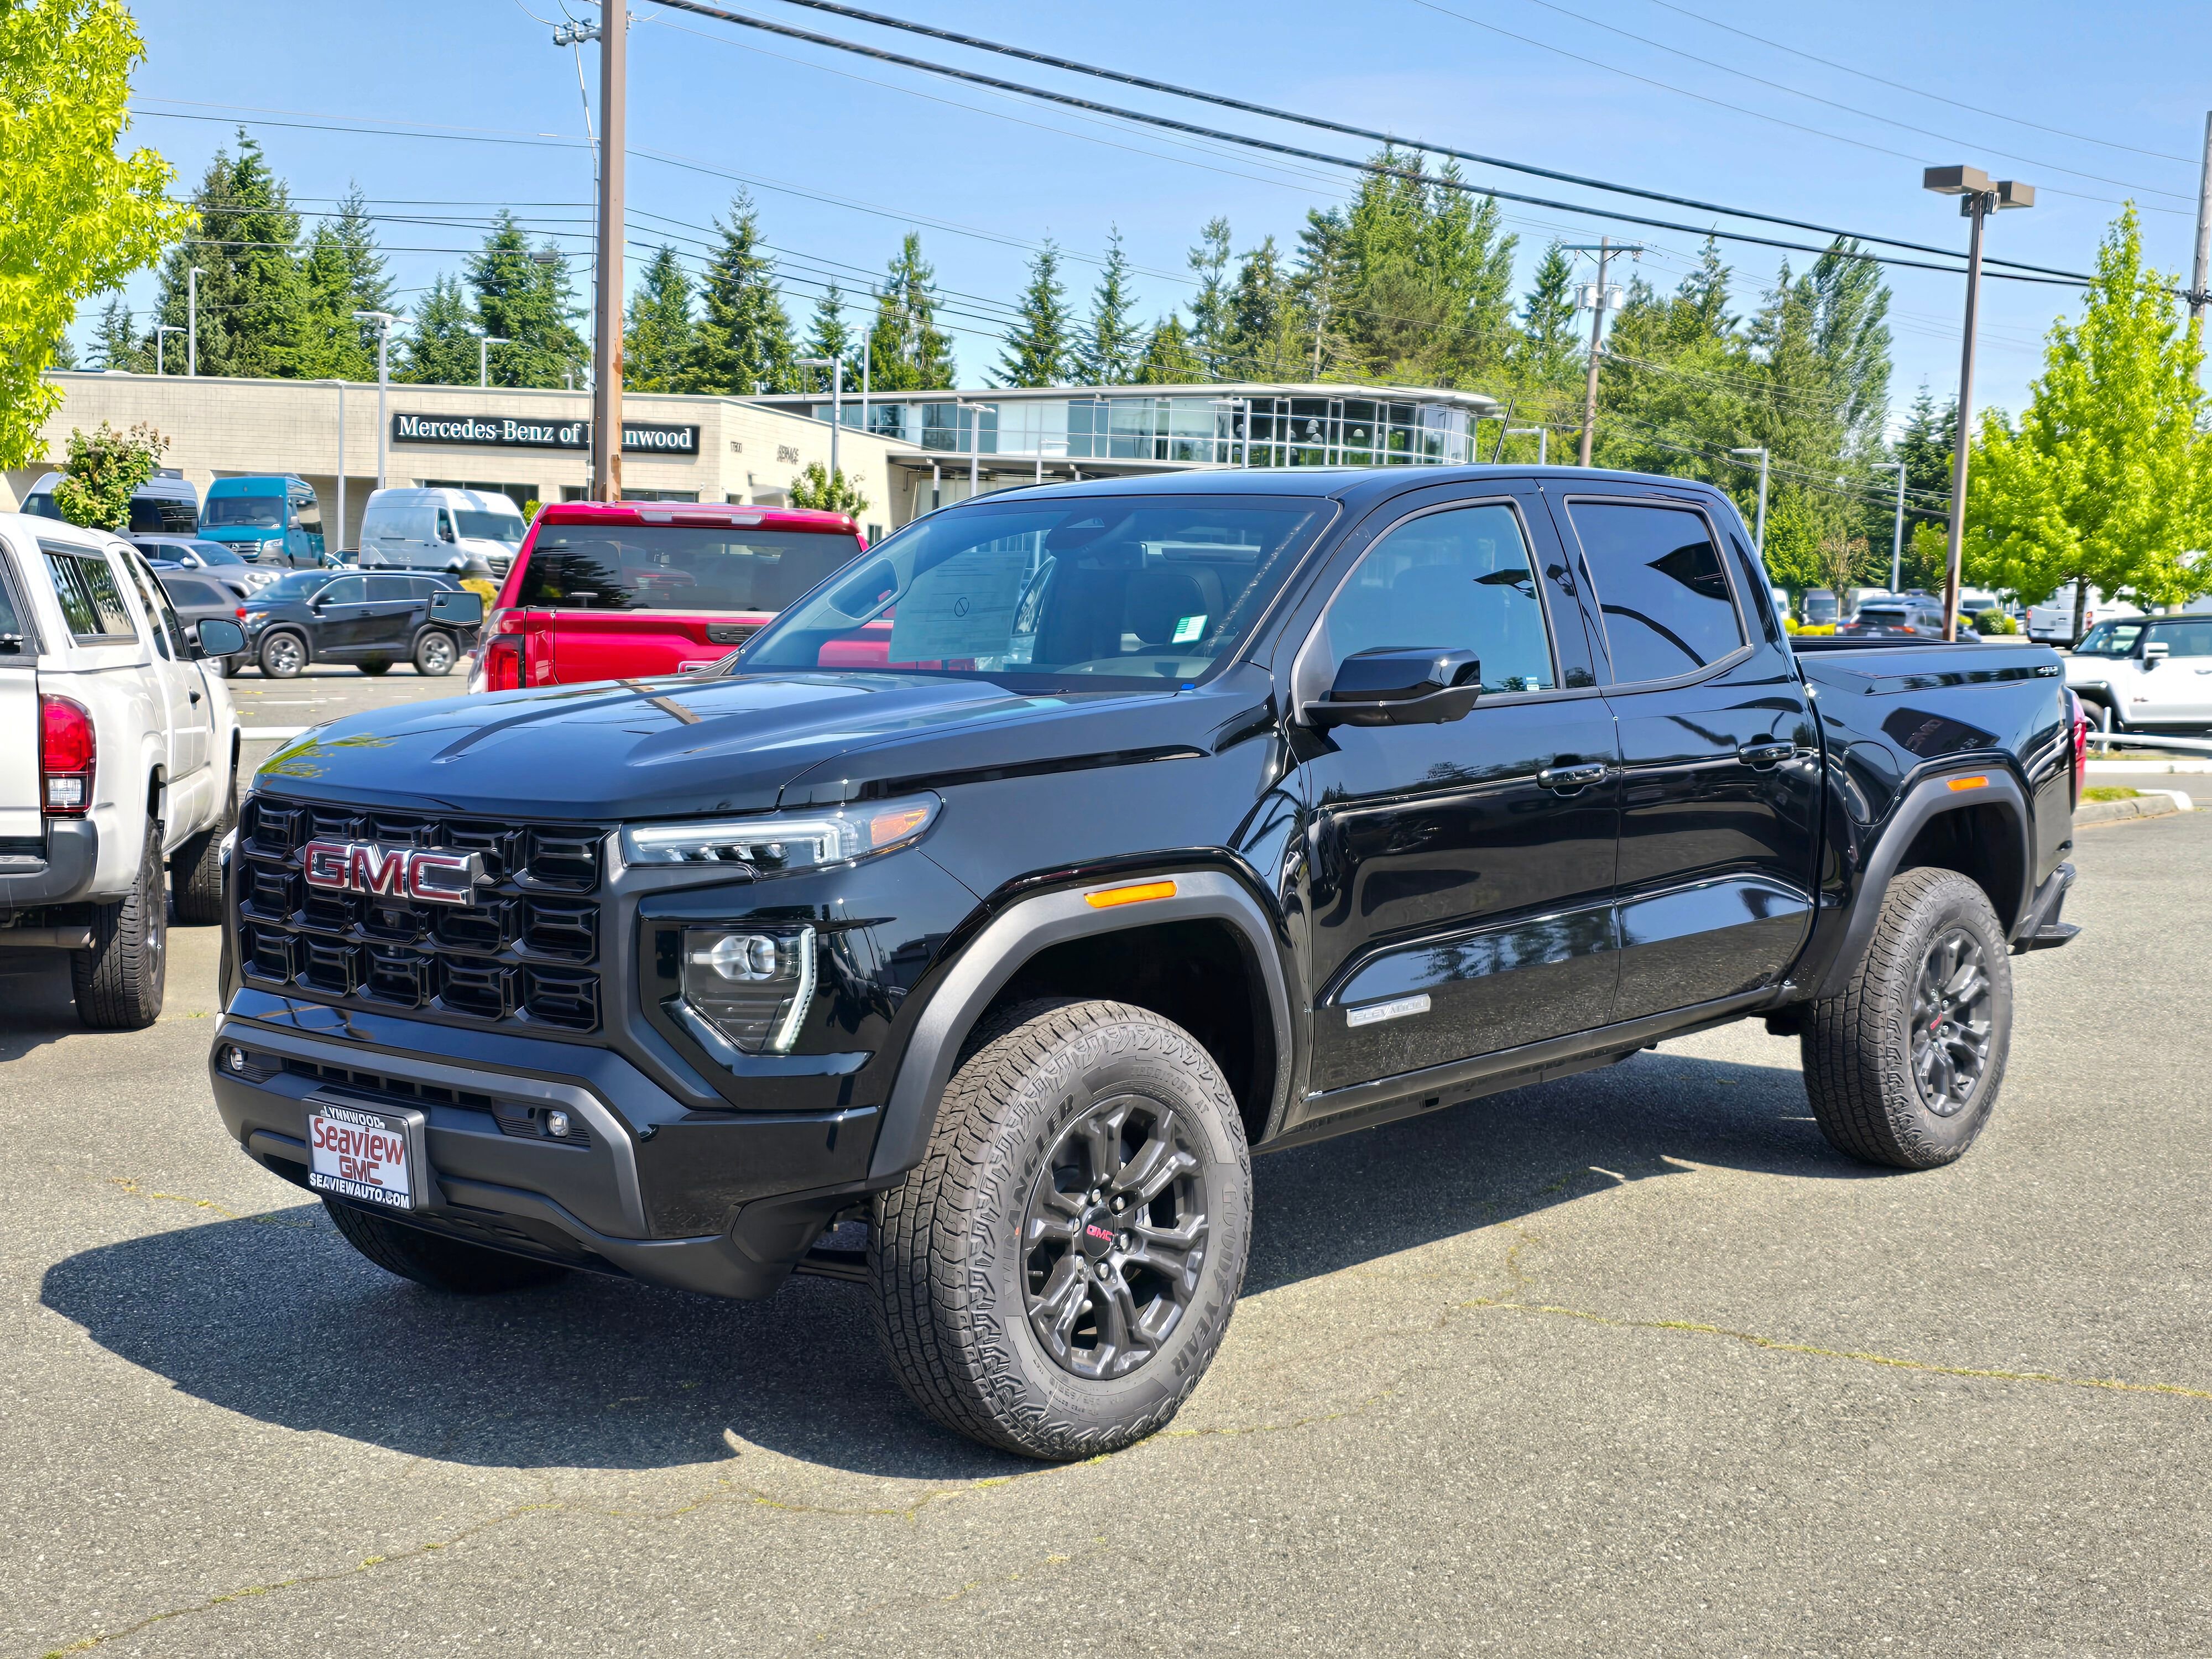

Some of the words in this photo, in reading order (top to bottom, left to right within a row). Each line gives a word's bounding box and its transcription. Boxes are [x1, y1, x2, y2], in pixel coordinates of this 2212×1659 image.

[398, 416, 553, 441] Mercedes-Benz
[560, 424, 580, 443] of
[304, 839, 484, 906] GMC
[1354, 999, 1425, 1020] ELEVATION
[323, 1105, 380, 1128] LYNNWOOD
[313, 1117, 404, 1165] Seaview
[338, 1155, 383, 1186] GMC
[310, 1172, 410, 1209] SEAVIEWAUTO.COM
[1086, 1224, 1113, 1242] GMC
